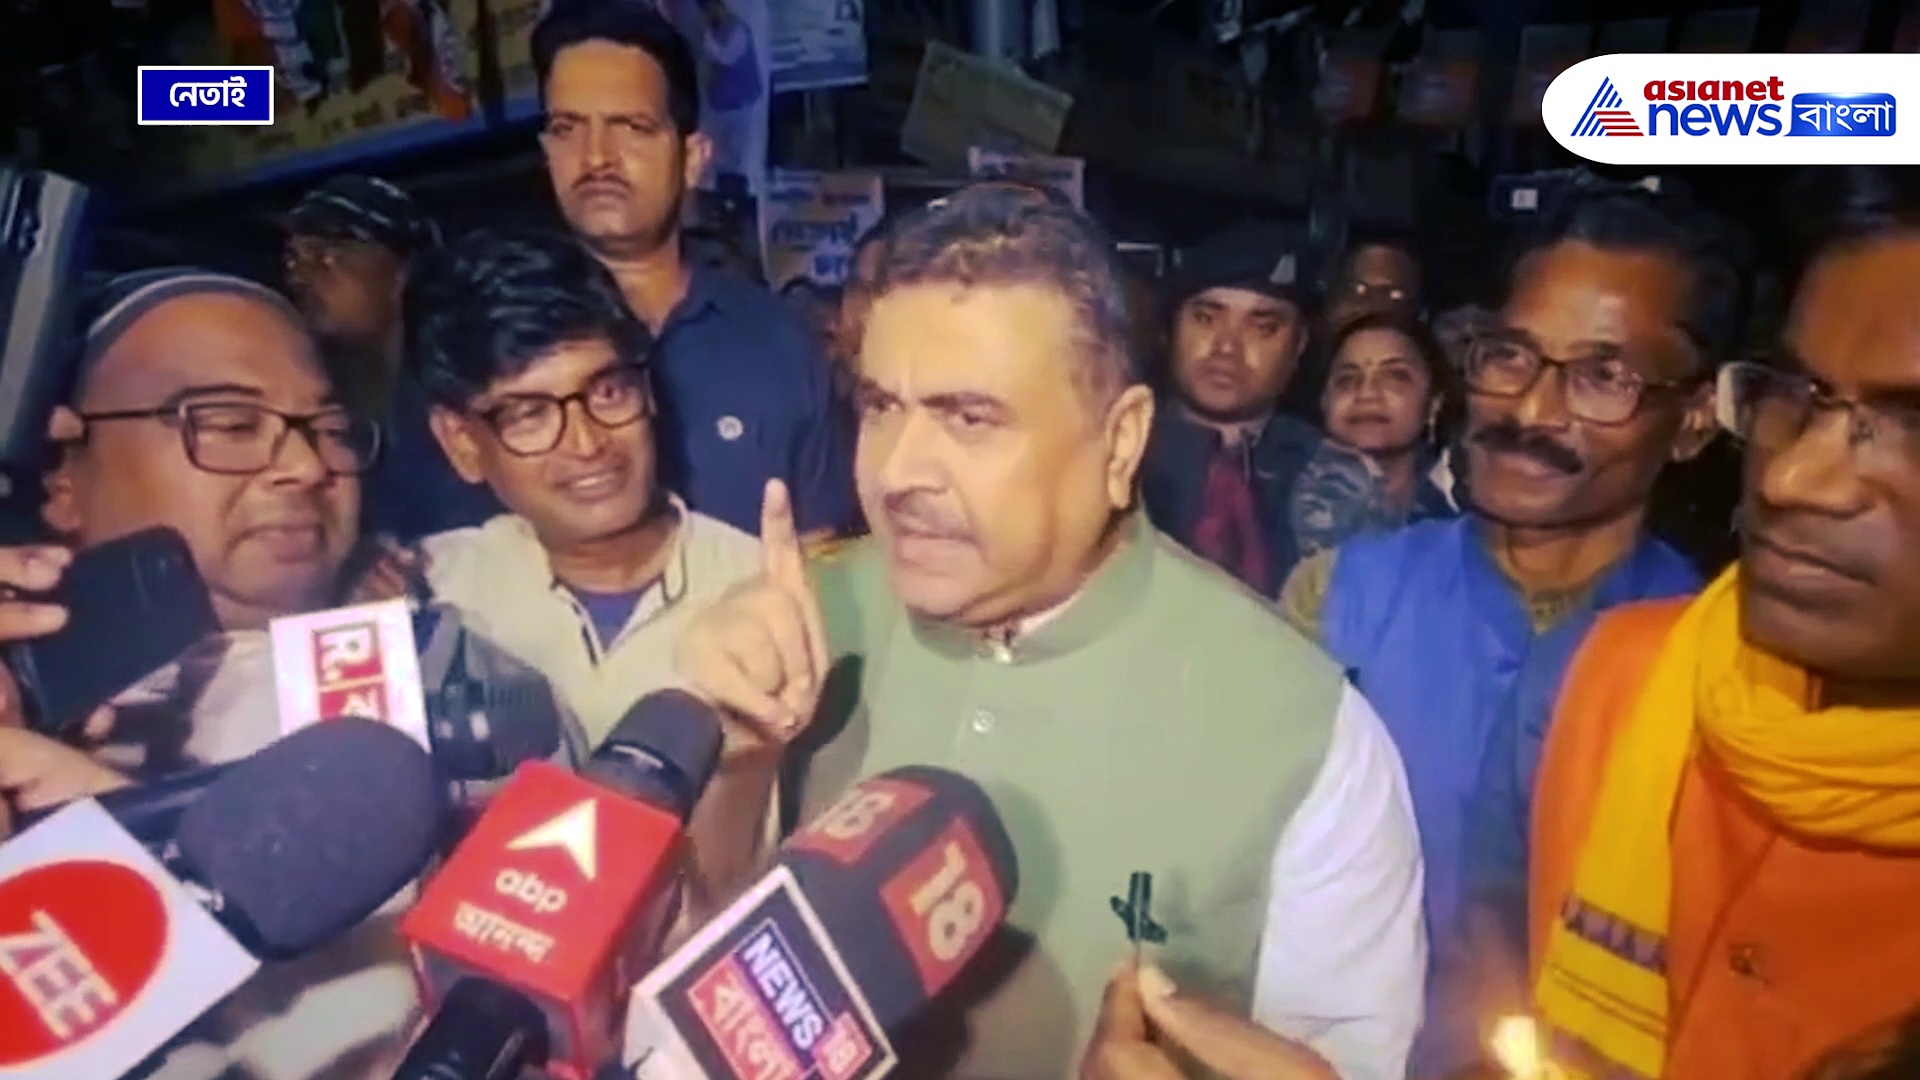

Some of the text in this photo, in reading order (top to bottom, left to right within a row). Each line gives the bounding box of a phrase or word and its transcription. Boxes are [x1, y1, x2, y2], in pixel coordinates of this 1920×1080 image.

[496, 868, 567, 912] abp
[909, 841, 984, 961] 18
[0, 909, 118, 1039] ZEE
[742, 932, 824, 1050] NEWS
